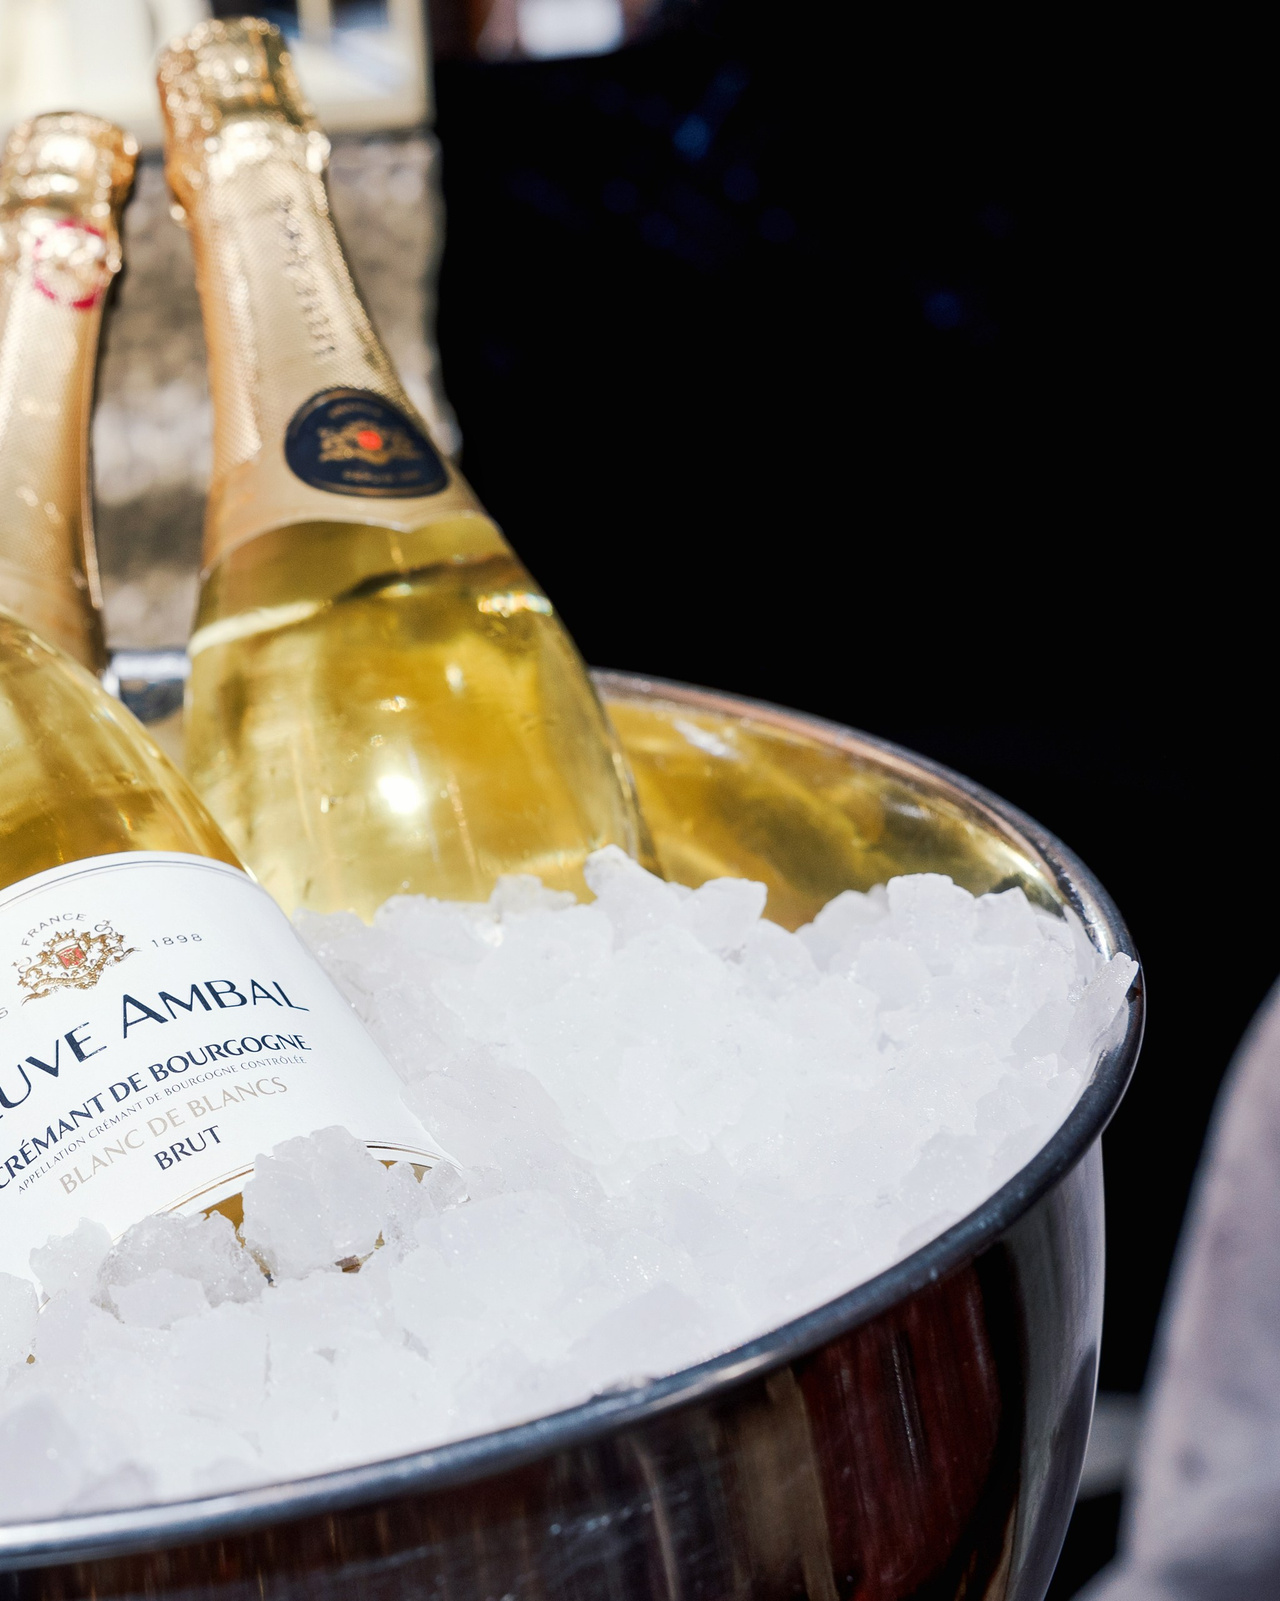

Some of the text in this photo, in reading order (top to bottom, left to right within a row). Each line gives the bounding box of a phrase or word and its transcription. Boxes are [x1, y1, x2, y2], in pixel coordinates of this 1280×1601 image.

[21, 912, 86, 947] FRANCE
[152, 933, 202, 948] 1898
[122, 978, 310, 1039] AMBAL
[109, 1072, 148, 1104] DE
[148, 1034, 312, 1083] BOURGOGNE
[18, 1055, 308, 1195] APPELLATION CRÉMANT DE BOURGOGNE CONTRÔLÉE
[58, 1076, 289, 1195] BLANC DE BLANCS
[153, 1124, 221, 1171] BRUT
